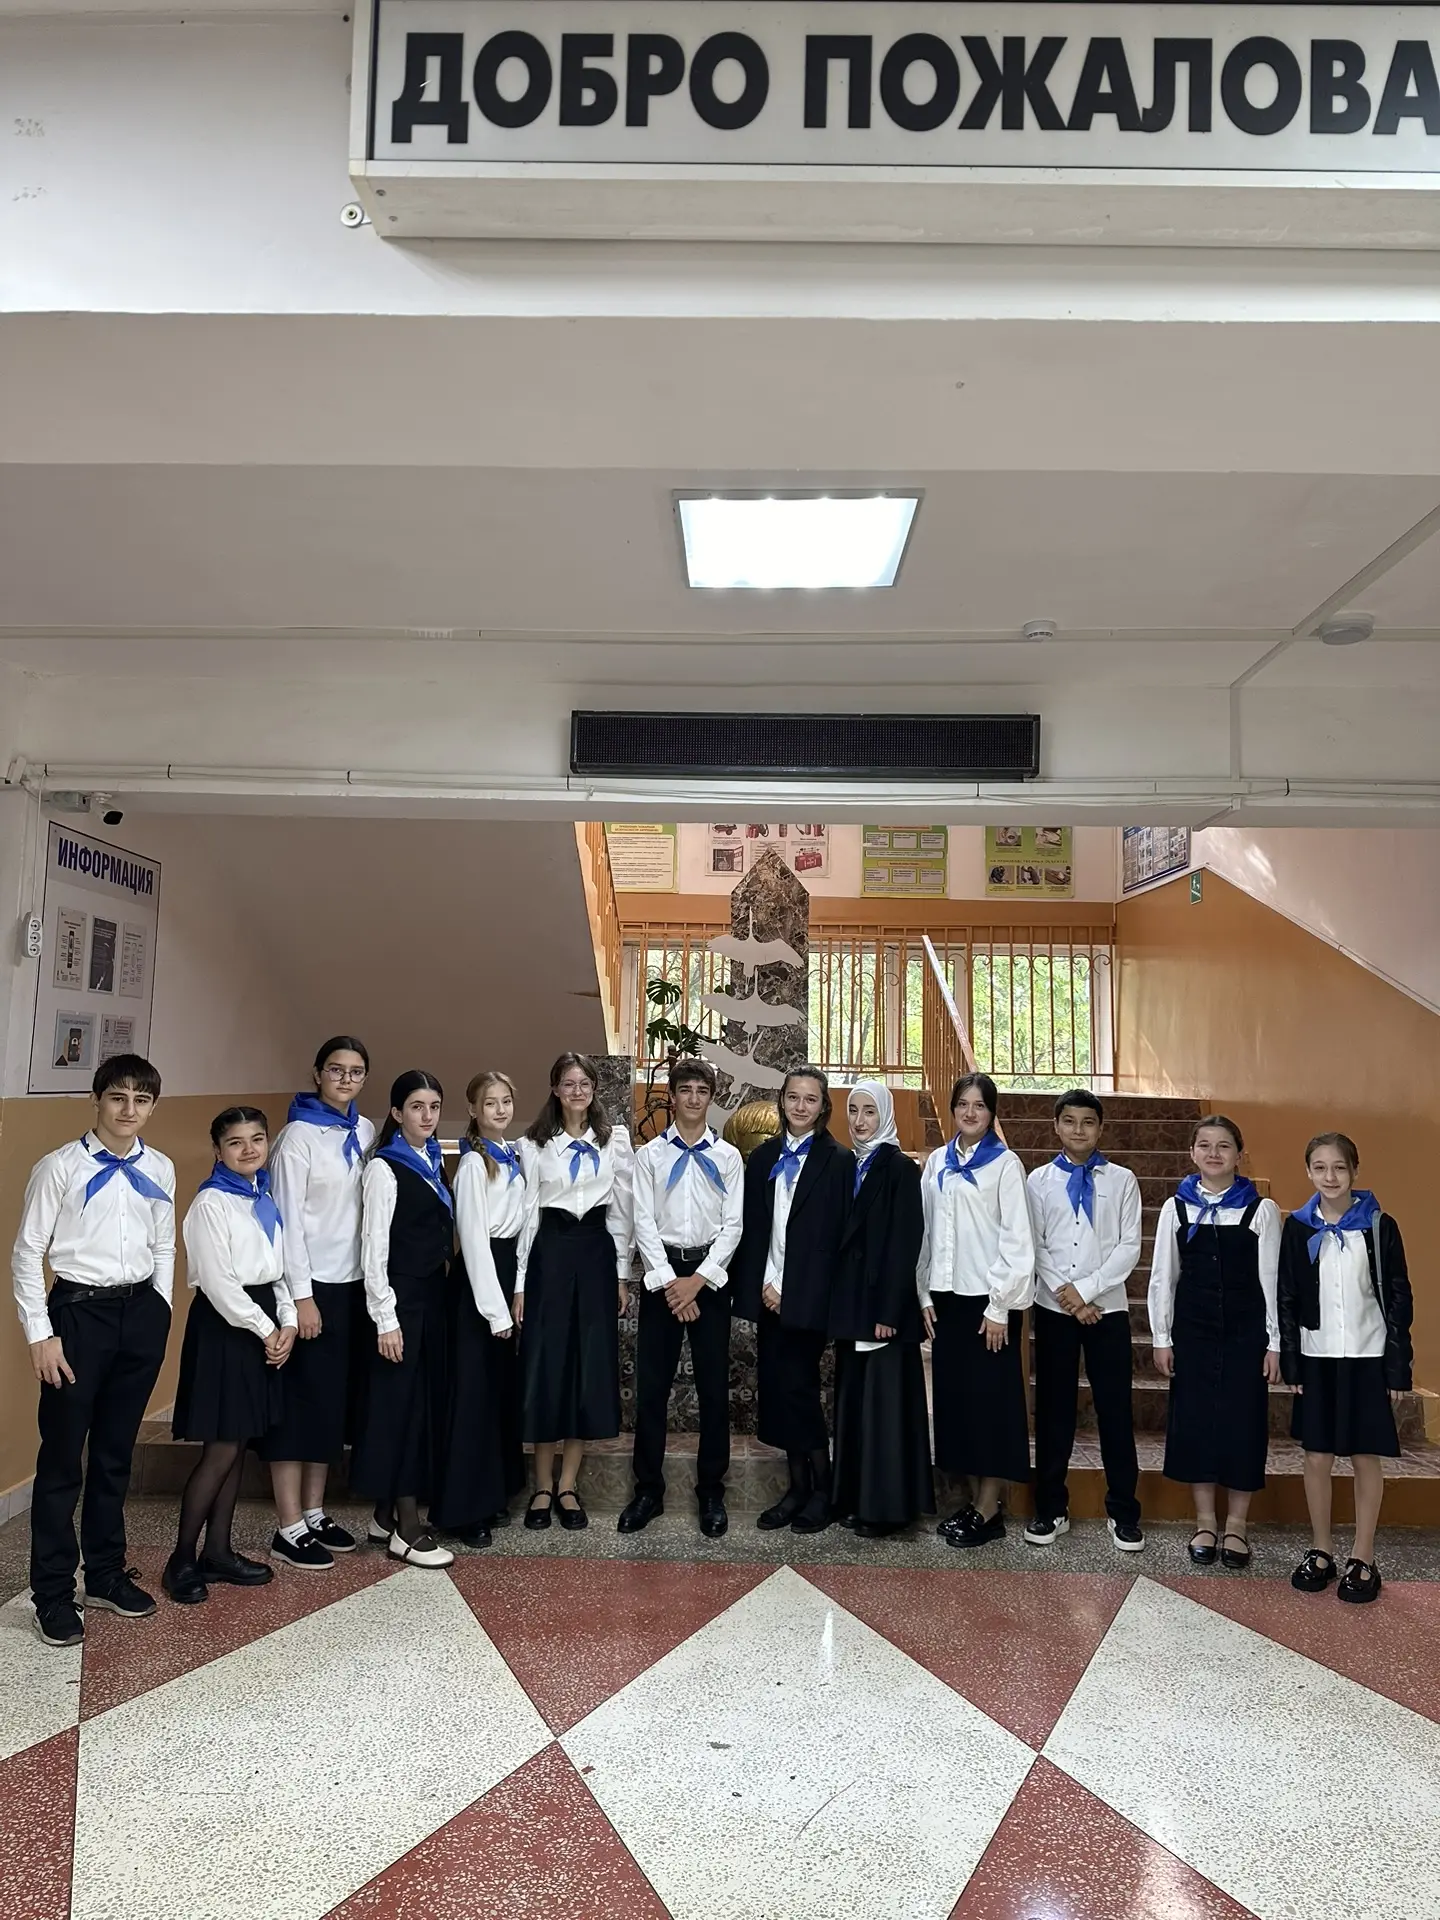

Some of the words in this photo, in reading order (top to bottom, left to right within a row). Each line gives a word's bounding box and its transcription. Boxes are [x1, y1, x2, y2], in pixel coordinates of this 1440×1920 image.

[391, 30, 769, 144] ДОБРО
[803, 33, 1440, 136] ПОЖАЛОВА
[58, 836, 154, 896] ИНФОРМАЦИЯ
